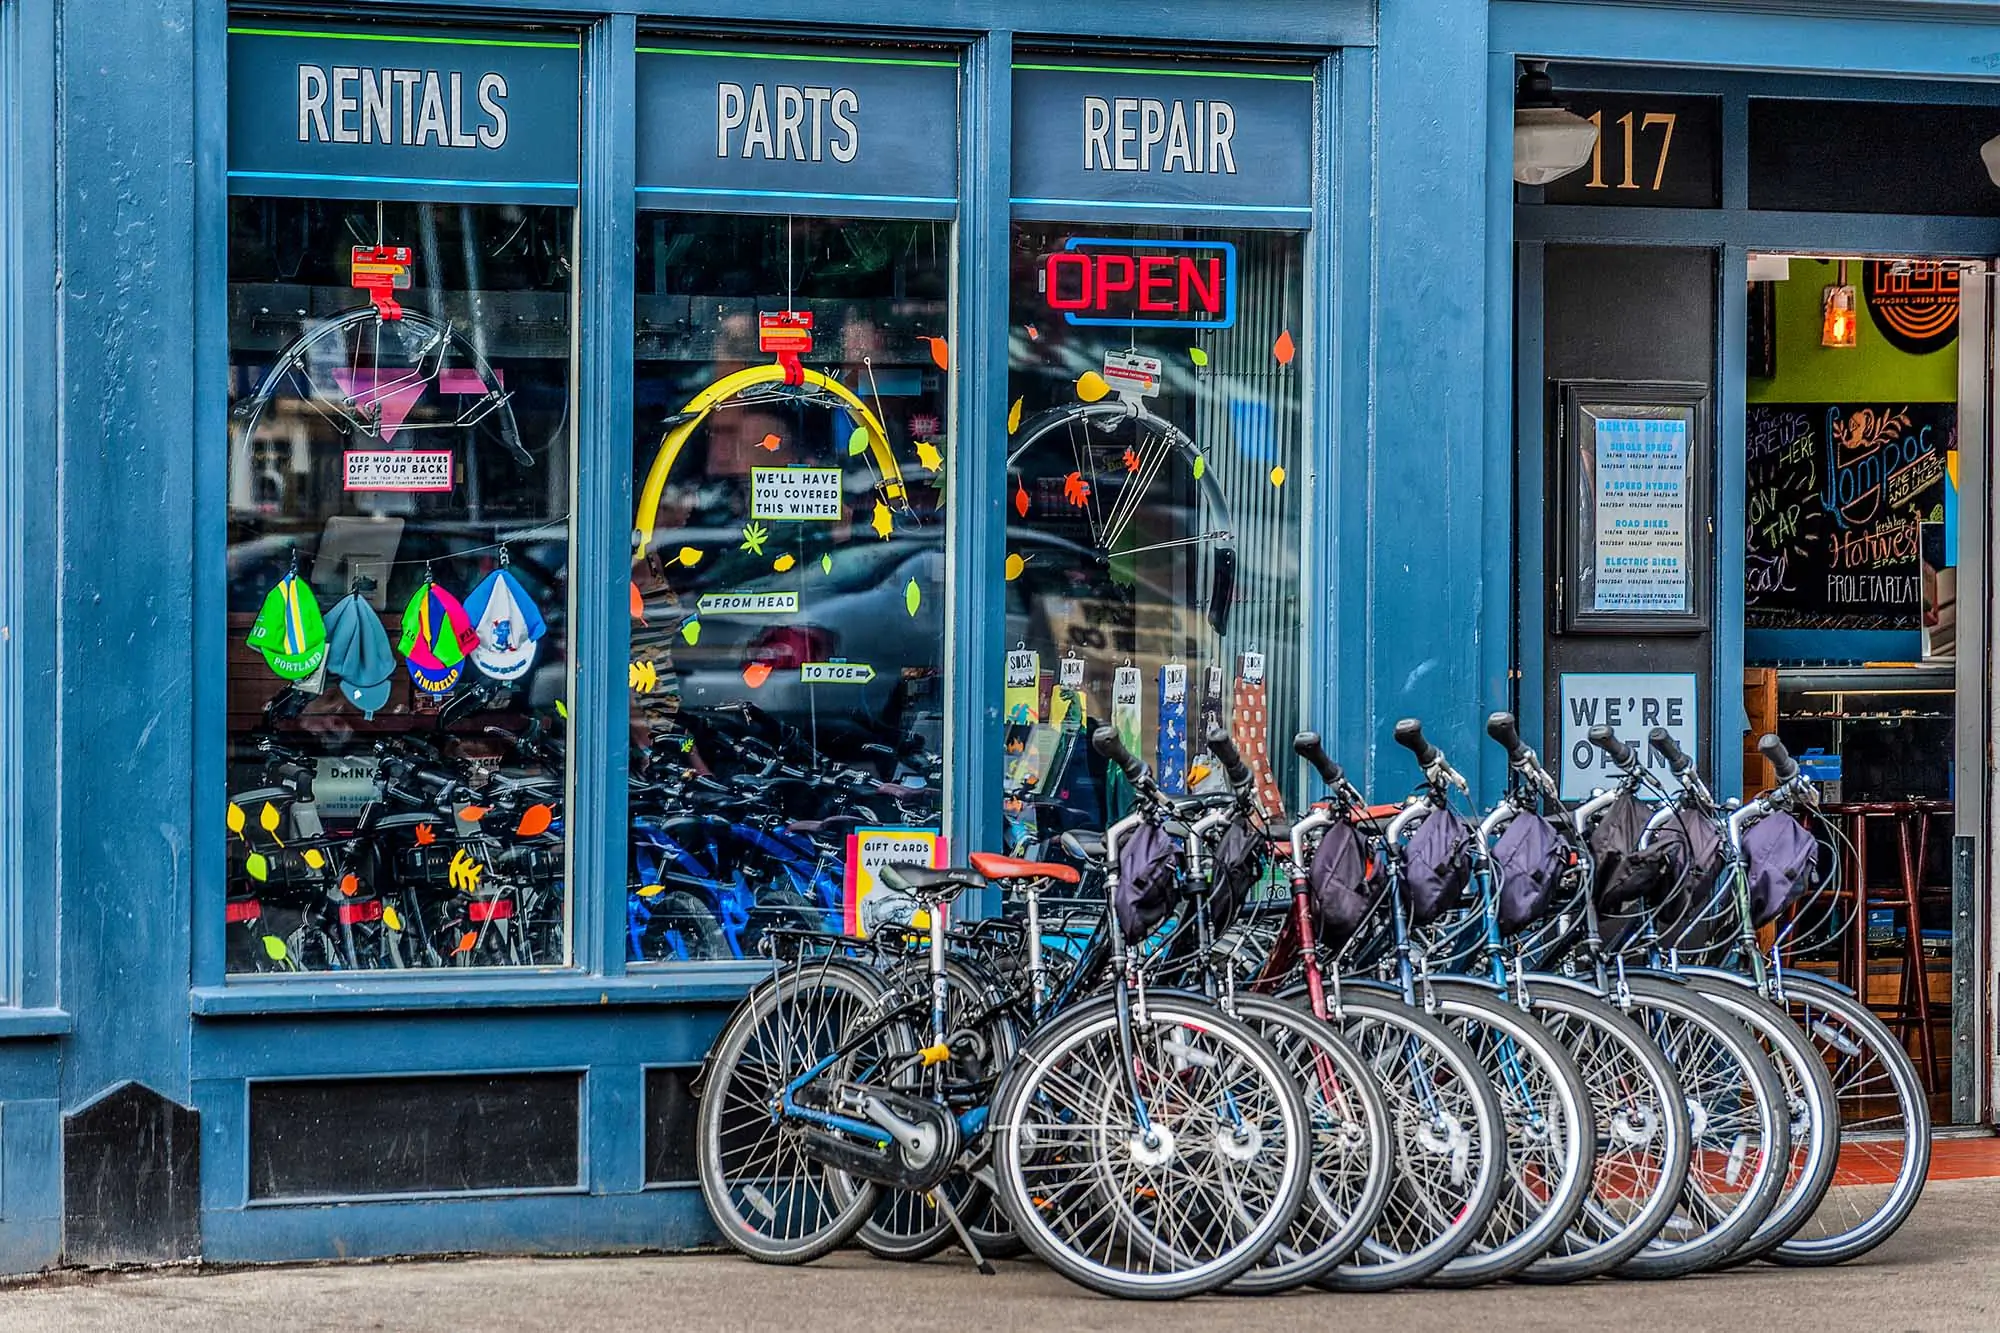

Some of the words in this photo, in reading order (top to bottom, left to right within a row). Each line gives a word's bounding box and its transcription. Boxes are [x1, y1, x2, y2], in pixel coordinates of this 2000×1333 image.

[298, 64, 508, 149] RENTALS
[717, 82, 859, 164] PARTS
[1083, 96, 1237, 174] REPAIR
[1585, 110, 1676, 190] 117
[1047, 253, 1220, 312] OPEN
[1645, 422, 1684, 432] PRICES
[1779, 432, 1816, 468] HERE
[349, 465, 369, 474] OFF
[375, 465, 406, 473] YOUR
[412, 465, 448, 473] BACK!
[756, 473, 795, 484] WE'LL
[802, 474, 837, 484] HAVE
[756, 489, 779, 498] YOU
[784, 489, 838, 499] COVERED
[1889, 482, 1909, 504] AND
[756, 504, 784, 513] THIS
[790, 504, 838, 514] WINTER
[1615, 520, 1640, 528] ROAD
[1643, 520, 1669, 528] BIKES
[1762, 504, 1800, 549] TAP
[1605, 558, 1648, 566] ELECTRIC
[1652, 558, 1677, 566] BIKES
[1827, 574, 1920, 603] PROLETARIAT
[714, 597, 751, 609] FROM
[757, 596, 795, 608] HEAD
[273, 652, 323, 672] PORTLAND
[805, 667, 821, 678] TO
[828, 667, 853, 678] TOE
[414, 669, 459, 692] PINARELLO
[1569, 697, 1683, 726] WE'RE
[864, 842, 888, 852] GIFT
[893, 843, 929, 852] CARDS
